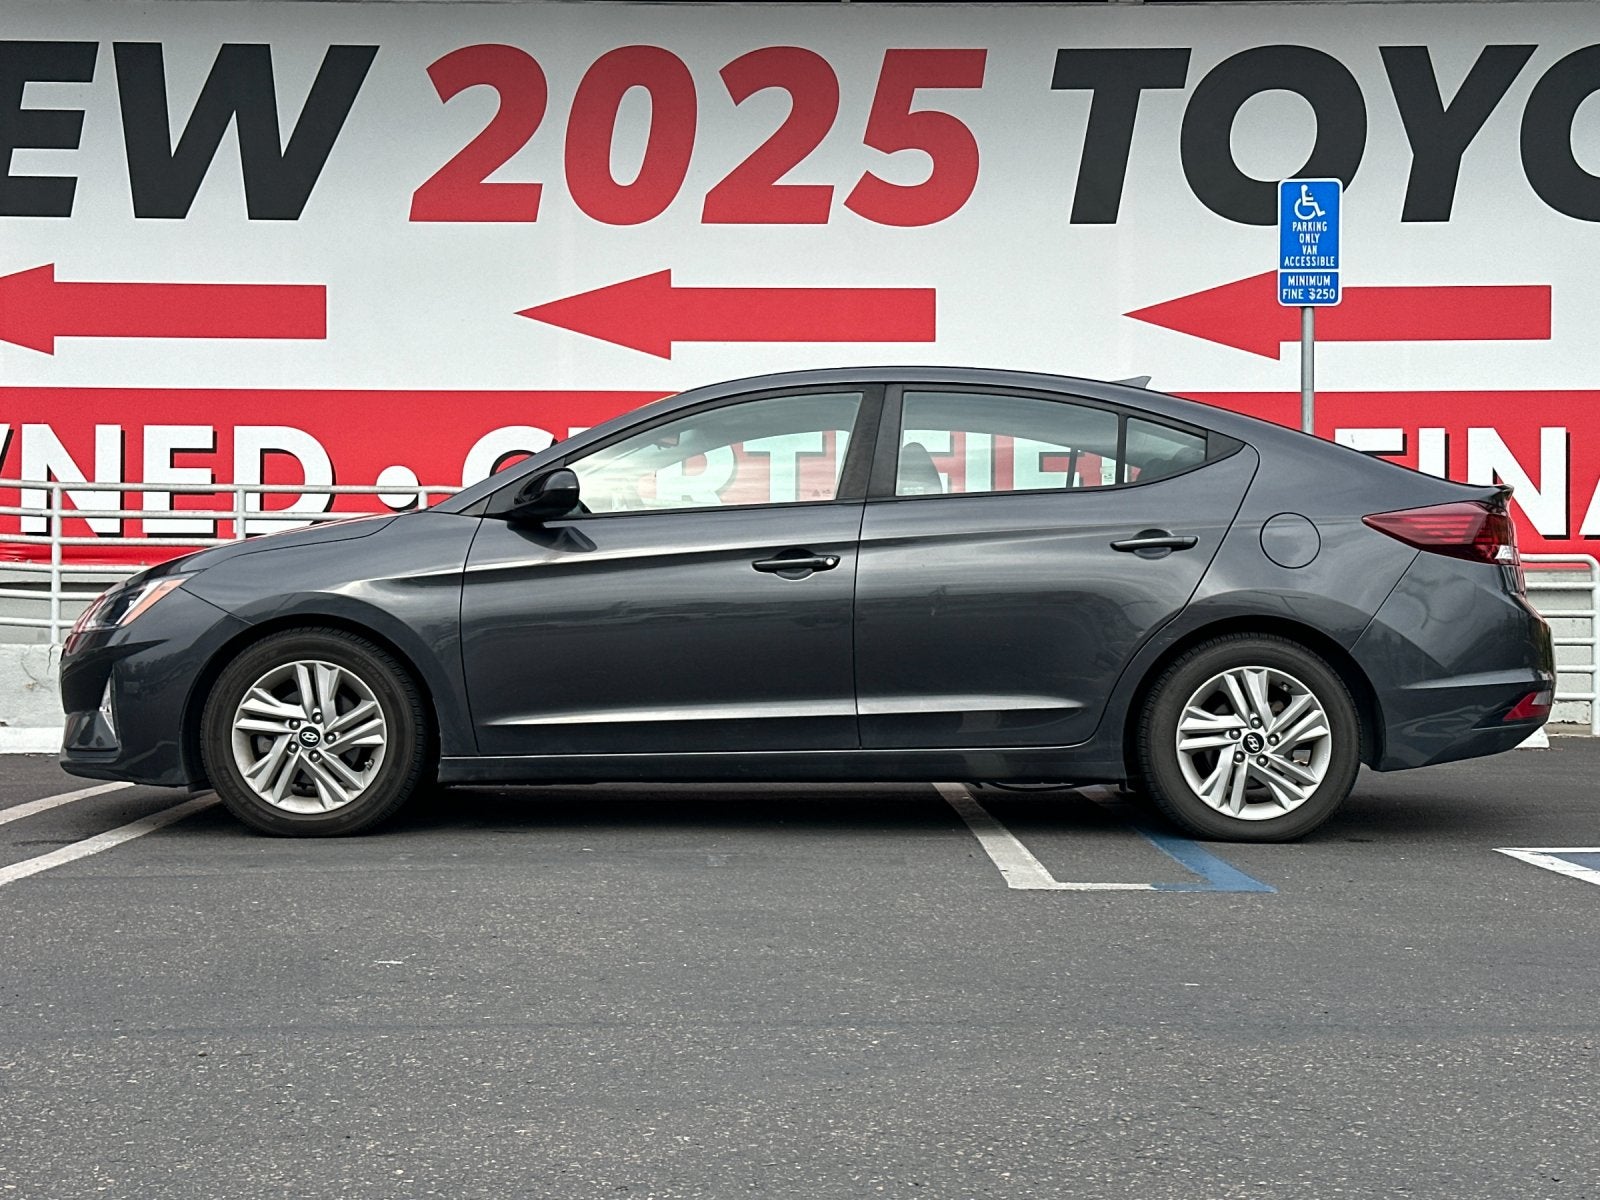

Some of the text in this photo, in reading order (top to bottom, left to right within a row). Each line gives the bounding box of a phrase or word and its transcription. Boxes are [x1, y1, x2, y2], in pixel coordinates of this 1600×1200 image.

[408, 43, 989, 227] 2025
[1292, 221, 1328, 232] PARKING
[1299, 233, 1320, 244] ONLY
[1302, 245, 1318, 255] VAN
[1284, 256, 1335, 267] ACCESSIBLE
[1287, 275, 1331, 287] MINIMUM
[1282, 287, 1336, 301] FINE $250
[0, 413, 337, 538] NED
